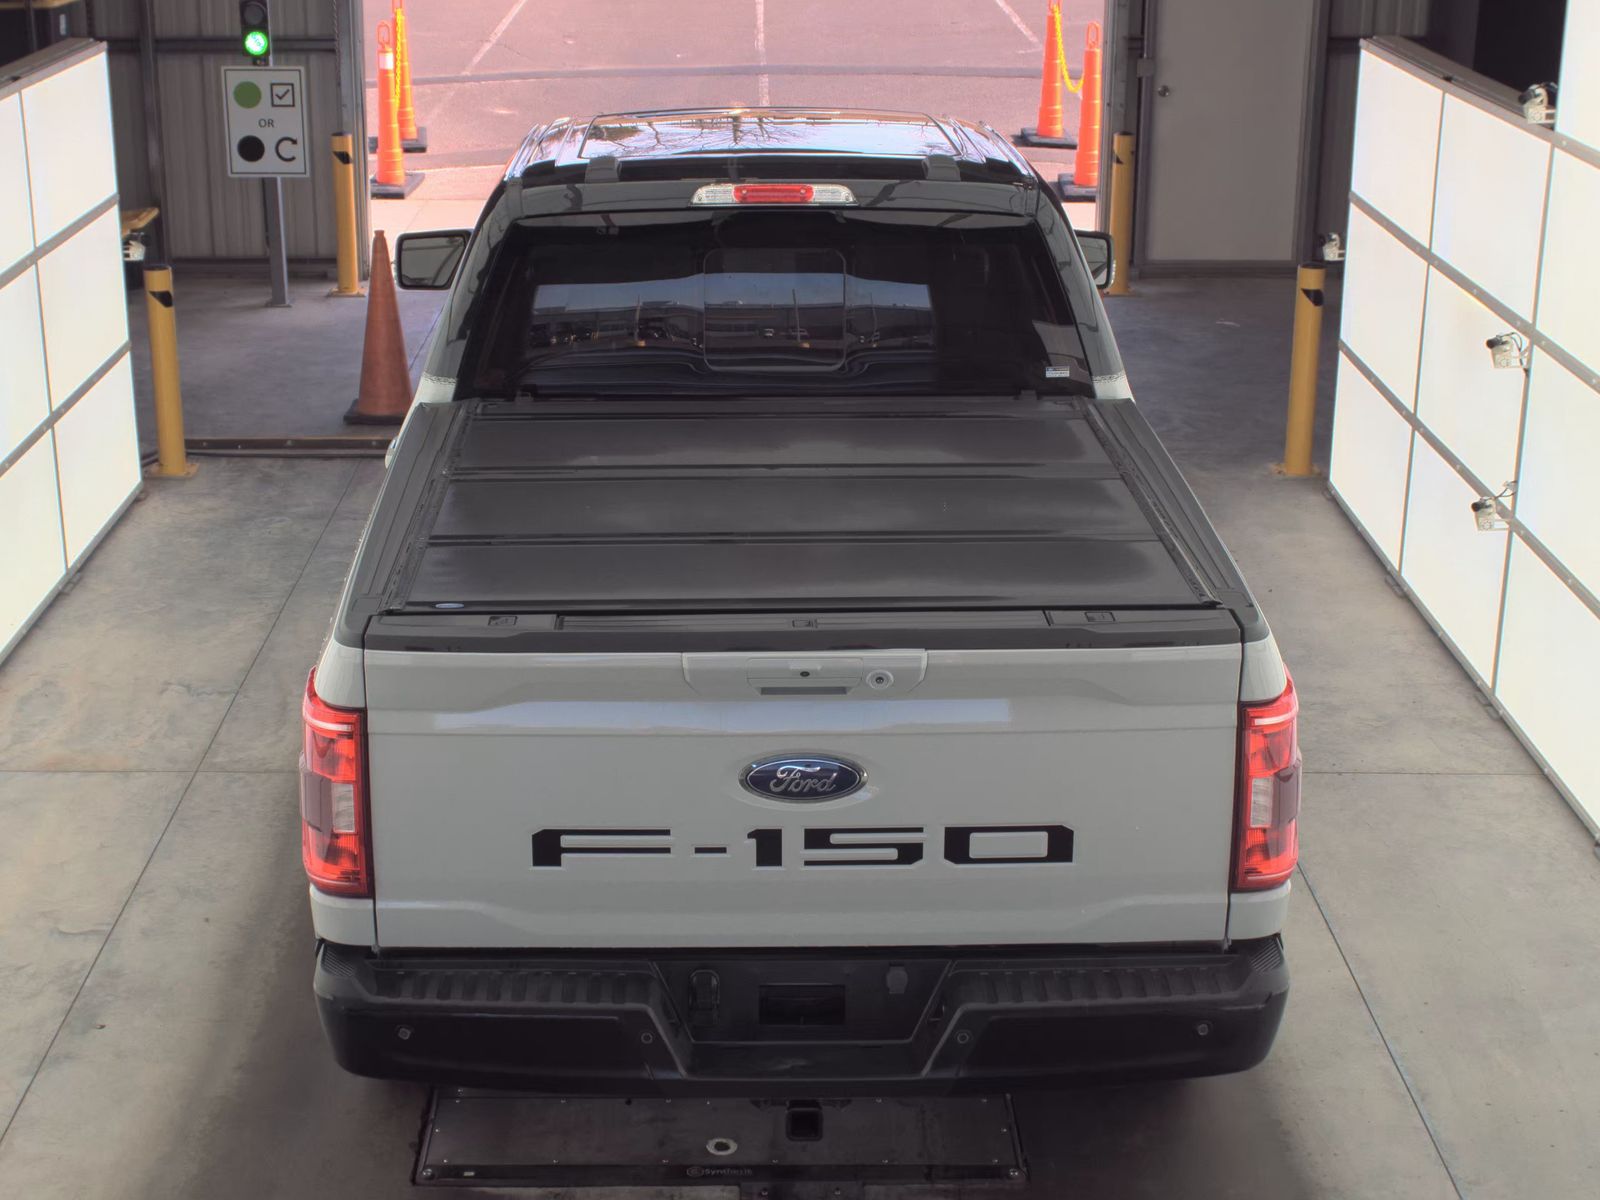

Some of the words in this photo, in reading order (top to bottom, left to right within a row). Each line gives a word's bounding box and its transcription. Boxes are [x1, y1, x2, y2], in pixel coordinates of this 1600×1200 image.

[258, 118, 275, 128] OR
[769, 765, 838, 792] Ford
[531, 825, 1074, 867] F-150
